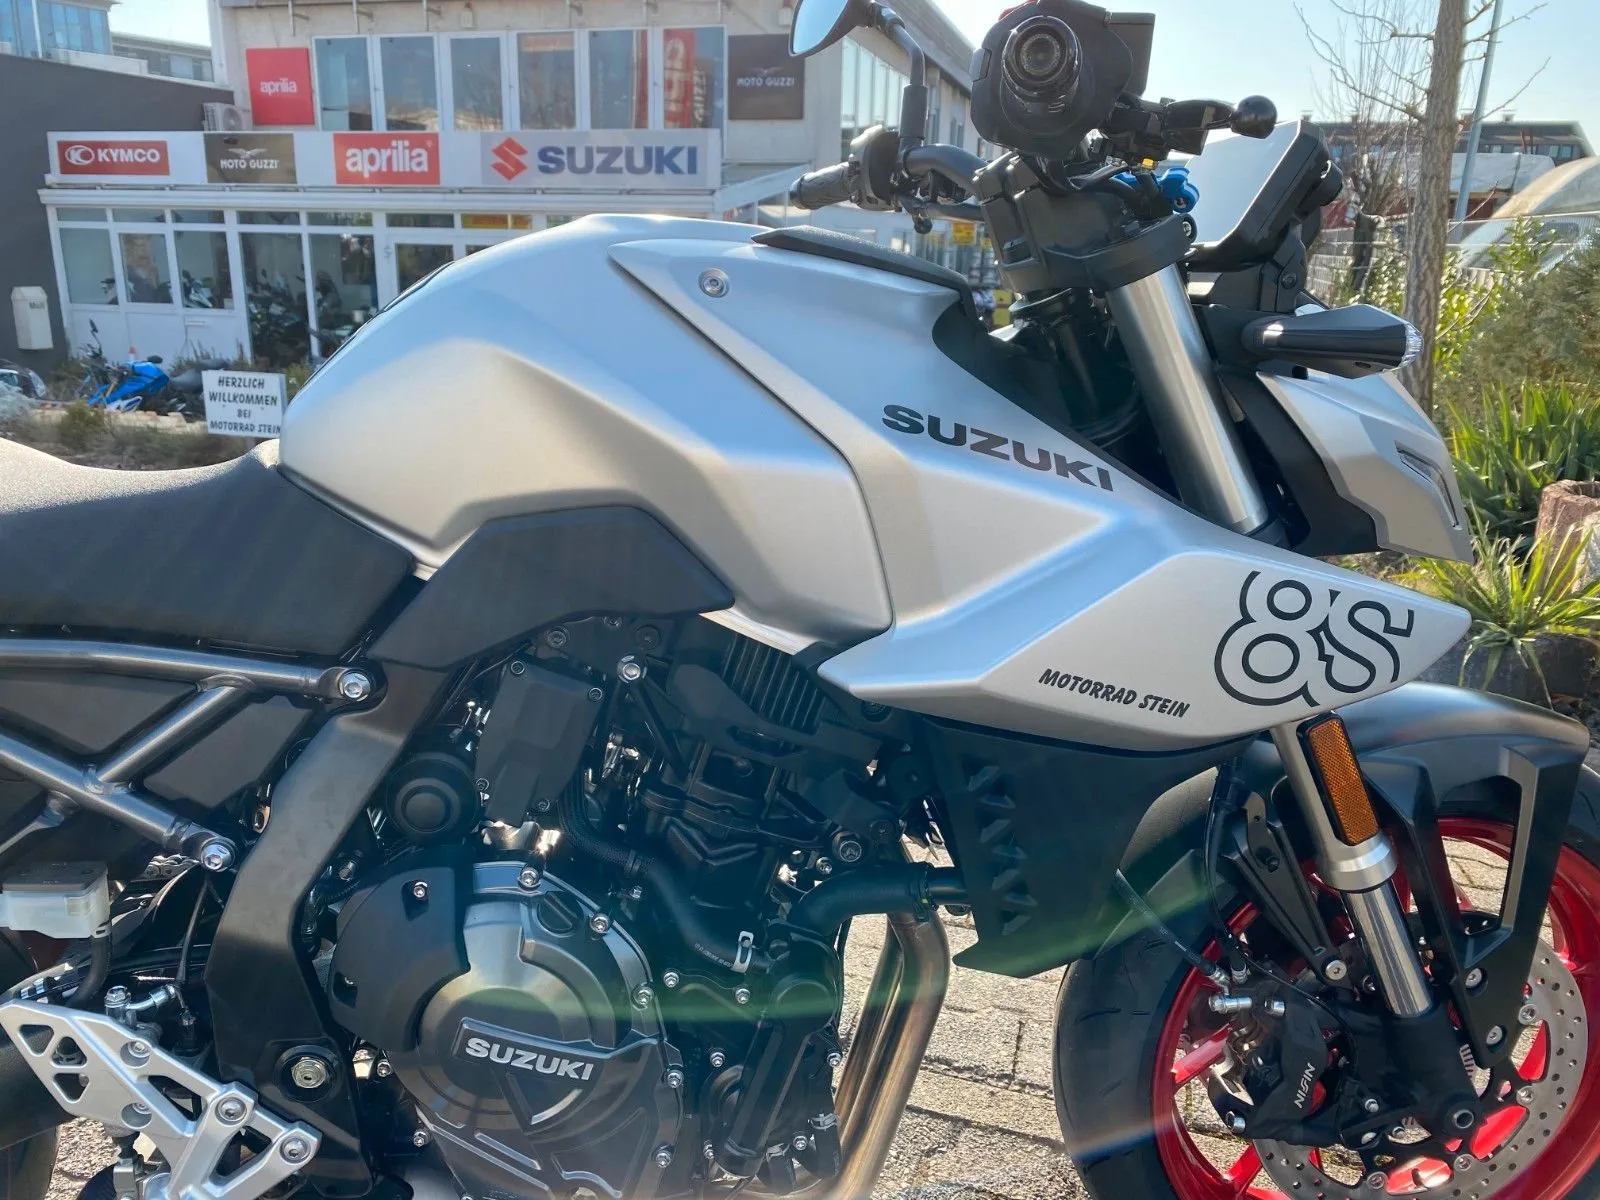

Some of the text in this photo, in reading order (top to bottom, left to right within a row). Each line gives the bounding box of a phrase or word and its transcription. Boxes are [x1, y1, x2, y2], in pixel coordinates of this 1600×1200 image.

[260, 78, 297, 95] aprilia
[737, 76, 796, 87] MOTO GUZZI
[97, 148, 160, 162] KYMCO
[345, 140, 429, 178] aprilia
[537, 146, 698, 175] SUZUKI
[220, 159, 278, 169] MOTO GUZZI
[218, 376, 265, 389] HERZLICH
[208, 391, 278, 406] WILLKOMMEN
[237, 409, 251, 419] BEI
[209, 420, 280, 434] MOTORRAD STEIN
[882, 404, 1114, 492] SUZUKI
[1038, 668, 1190, 718] MOTORRAD STEIN
[465, 1037, 594, 1081] SUZUKI
